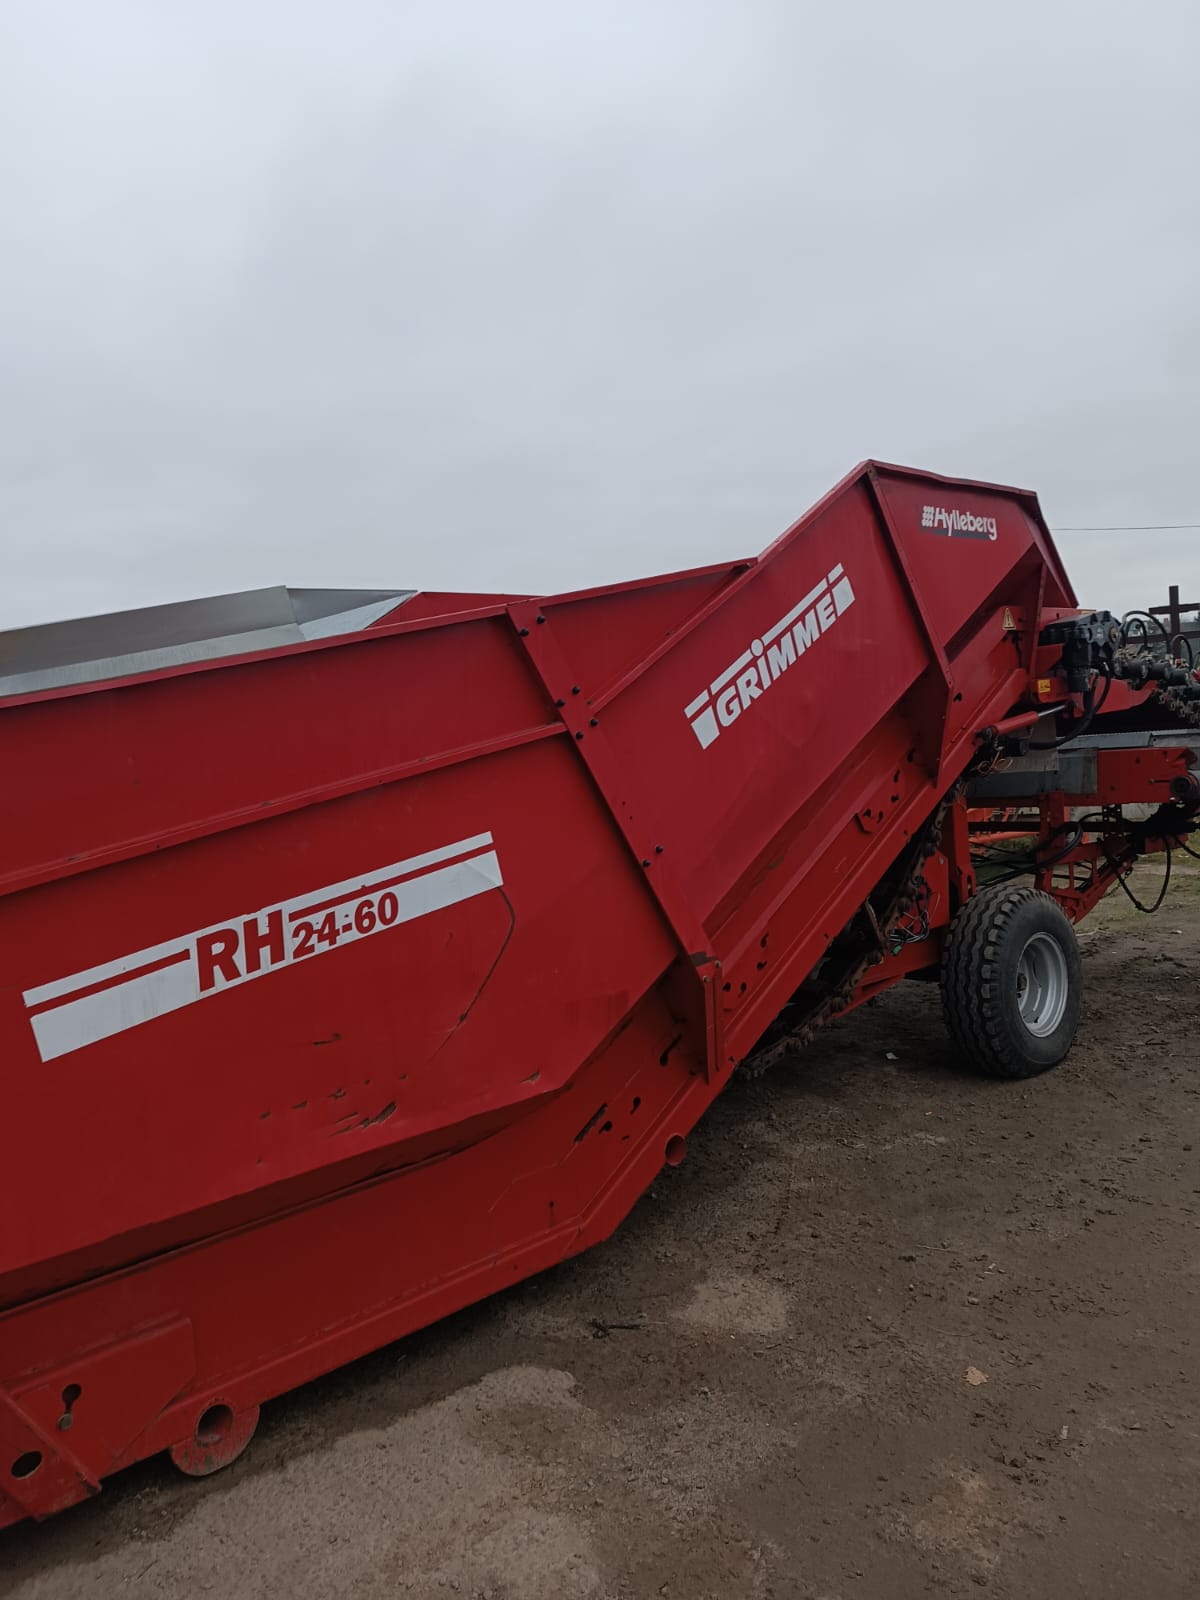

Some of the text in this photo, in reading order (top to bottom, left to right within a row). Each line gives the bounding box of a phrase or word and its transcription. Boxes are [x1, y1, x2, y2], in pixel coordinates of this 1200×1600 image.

[934, 507, 997, 541] Hylleberg
[196, 892, 399, 992] RH 24-60
